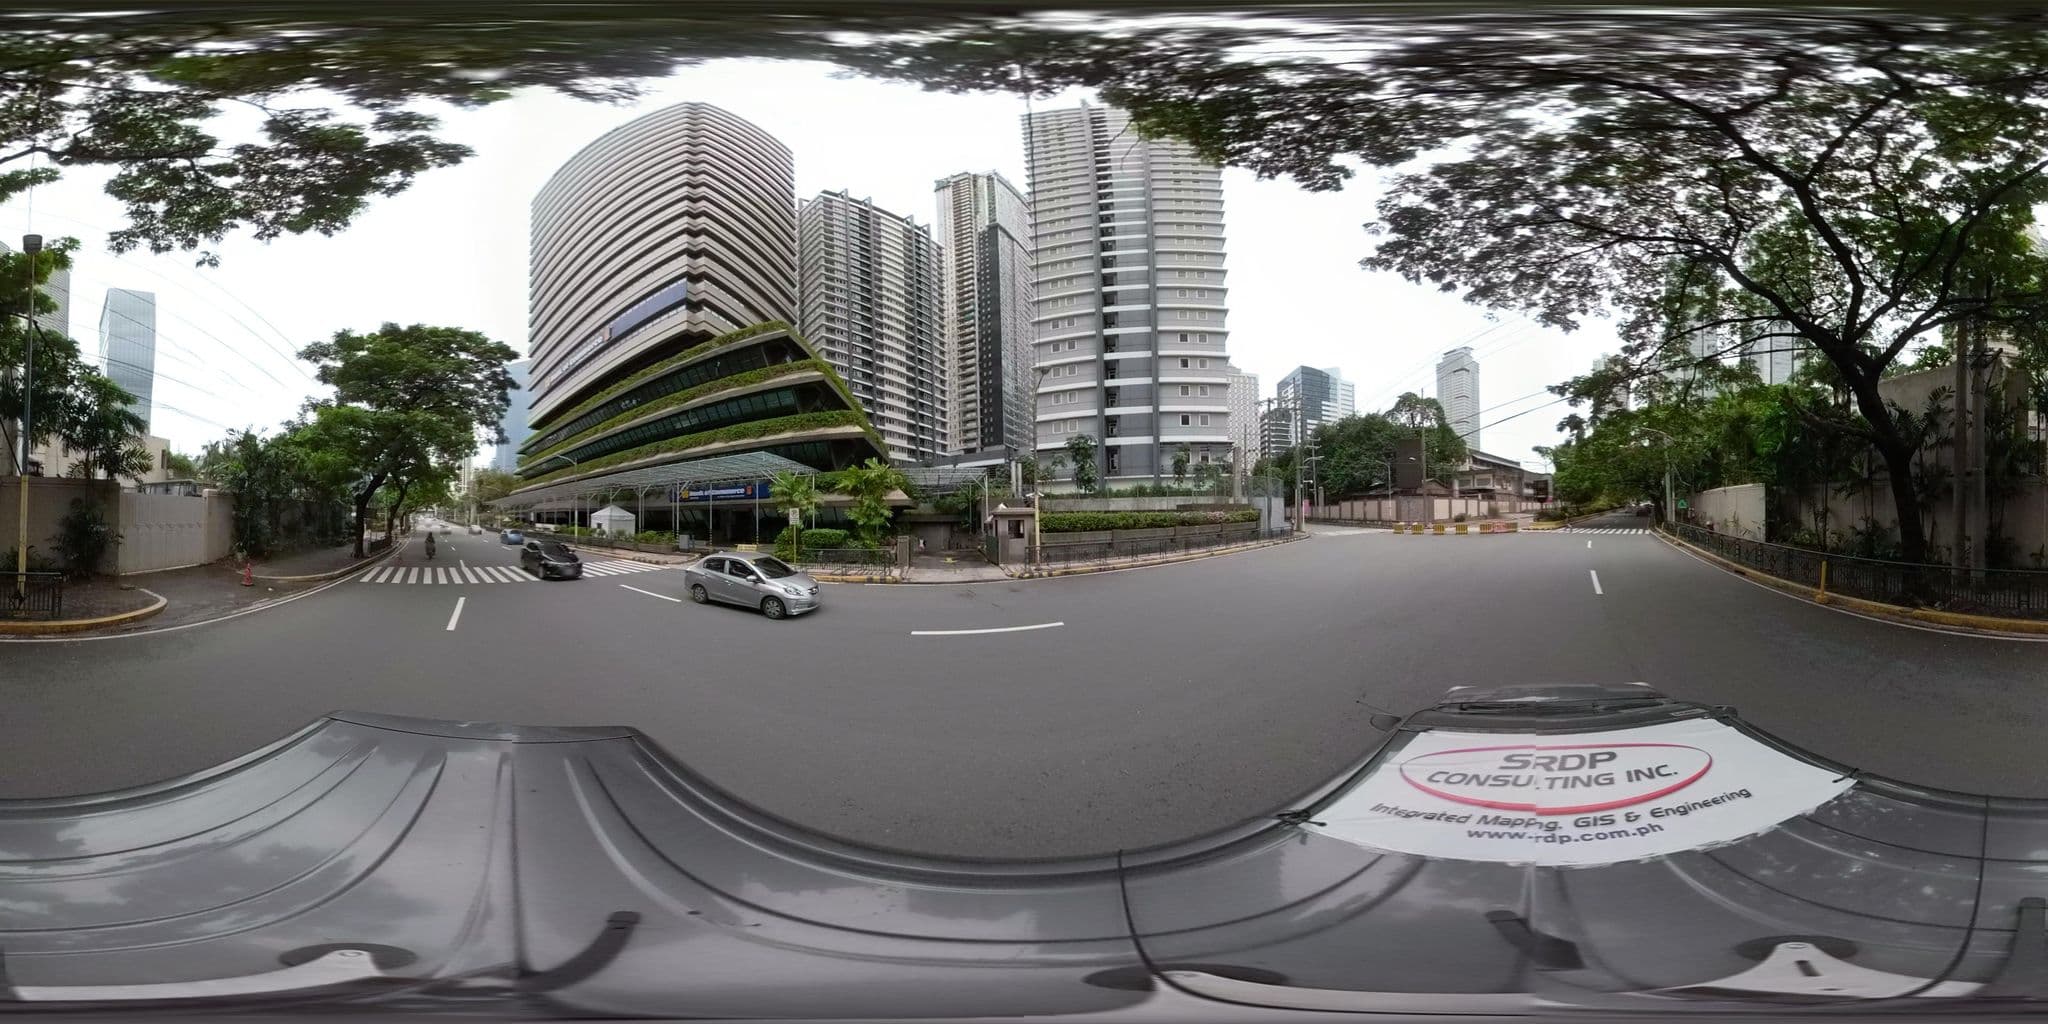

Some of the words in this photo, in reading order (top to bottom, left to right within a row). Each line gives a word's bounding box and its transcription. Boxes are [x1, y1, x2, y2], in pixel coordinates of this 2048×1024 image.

[1499, 751, 1616, 771] SRDP
[1427, 771, 1616, 791] CONSUTING
[1626, 764, 1678, 782] INC.
[1369, 803, 1472, 824] Integrated
[1573, 814, 1615, 828] GIS
[1624, 811, 1641, 823] &
[1650, 788, 1752, 818] Engineering
